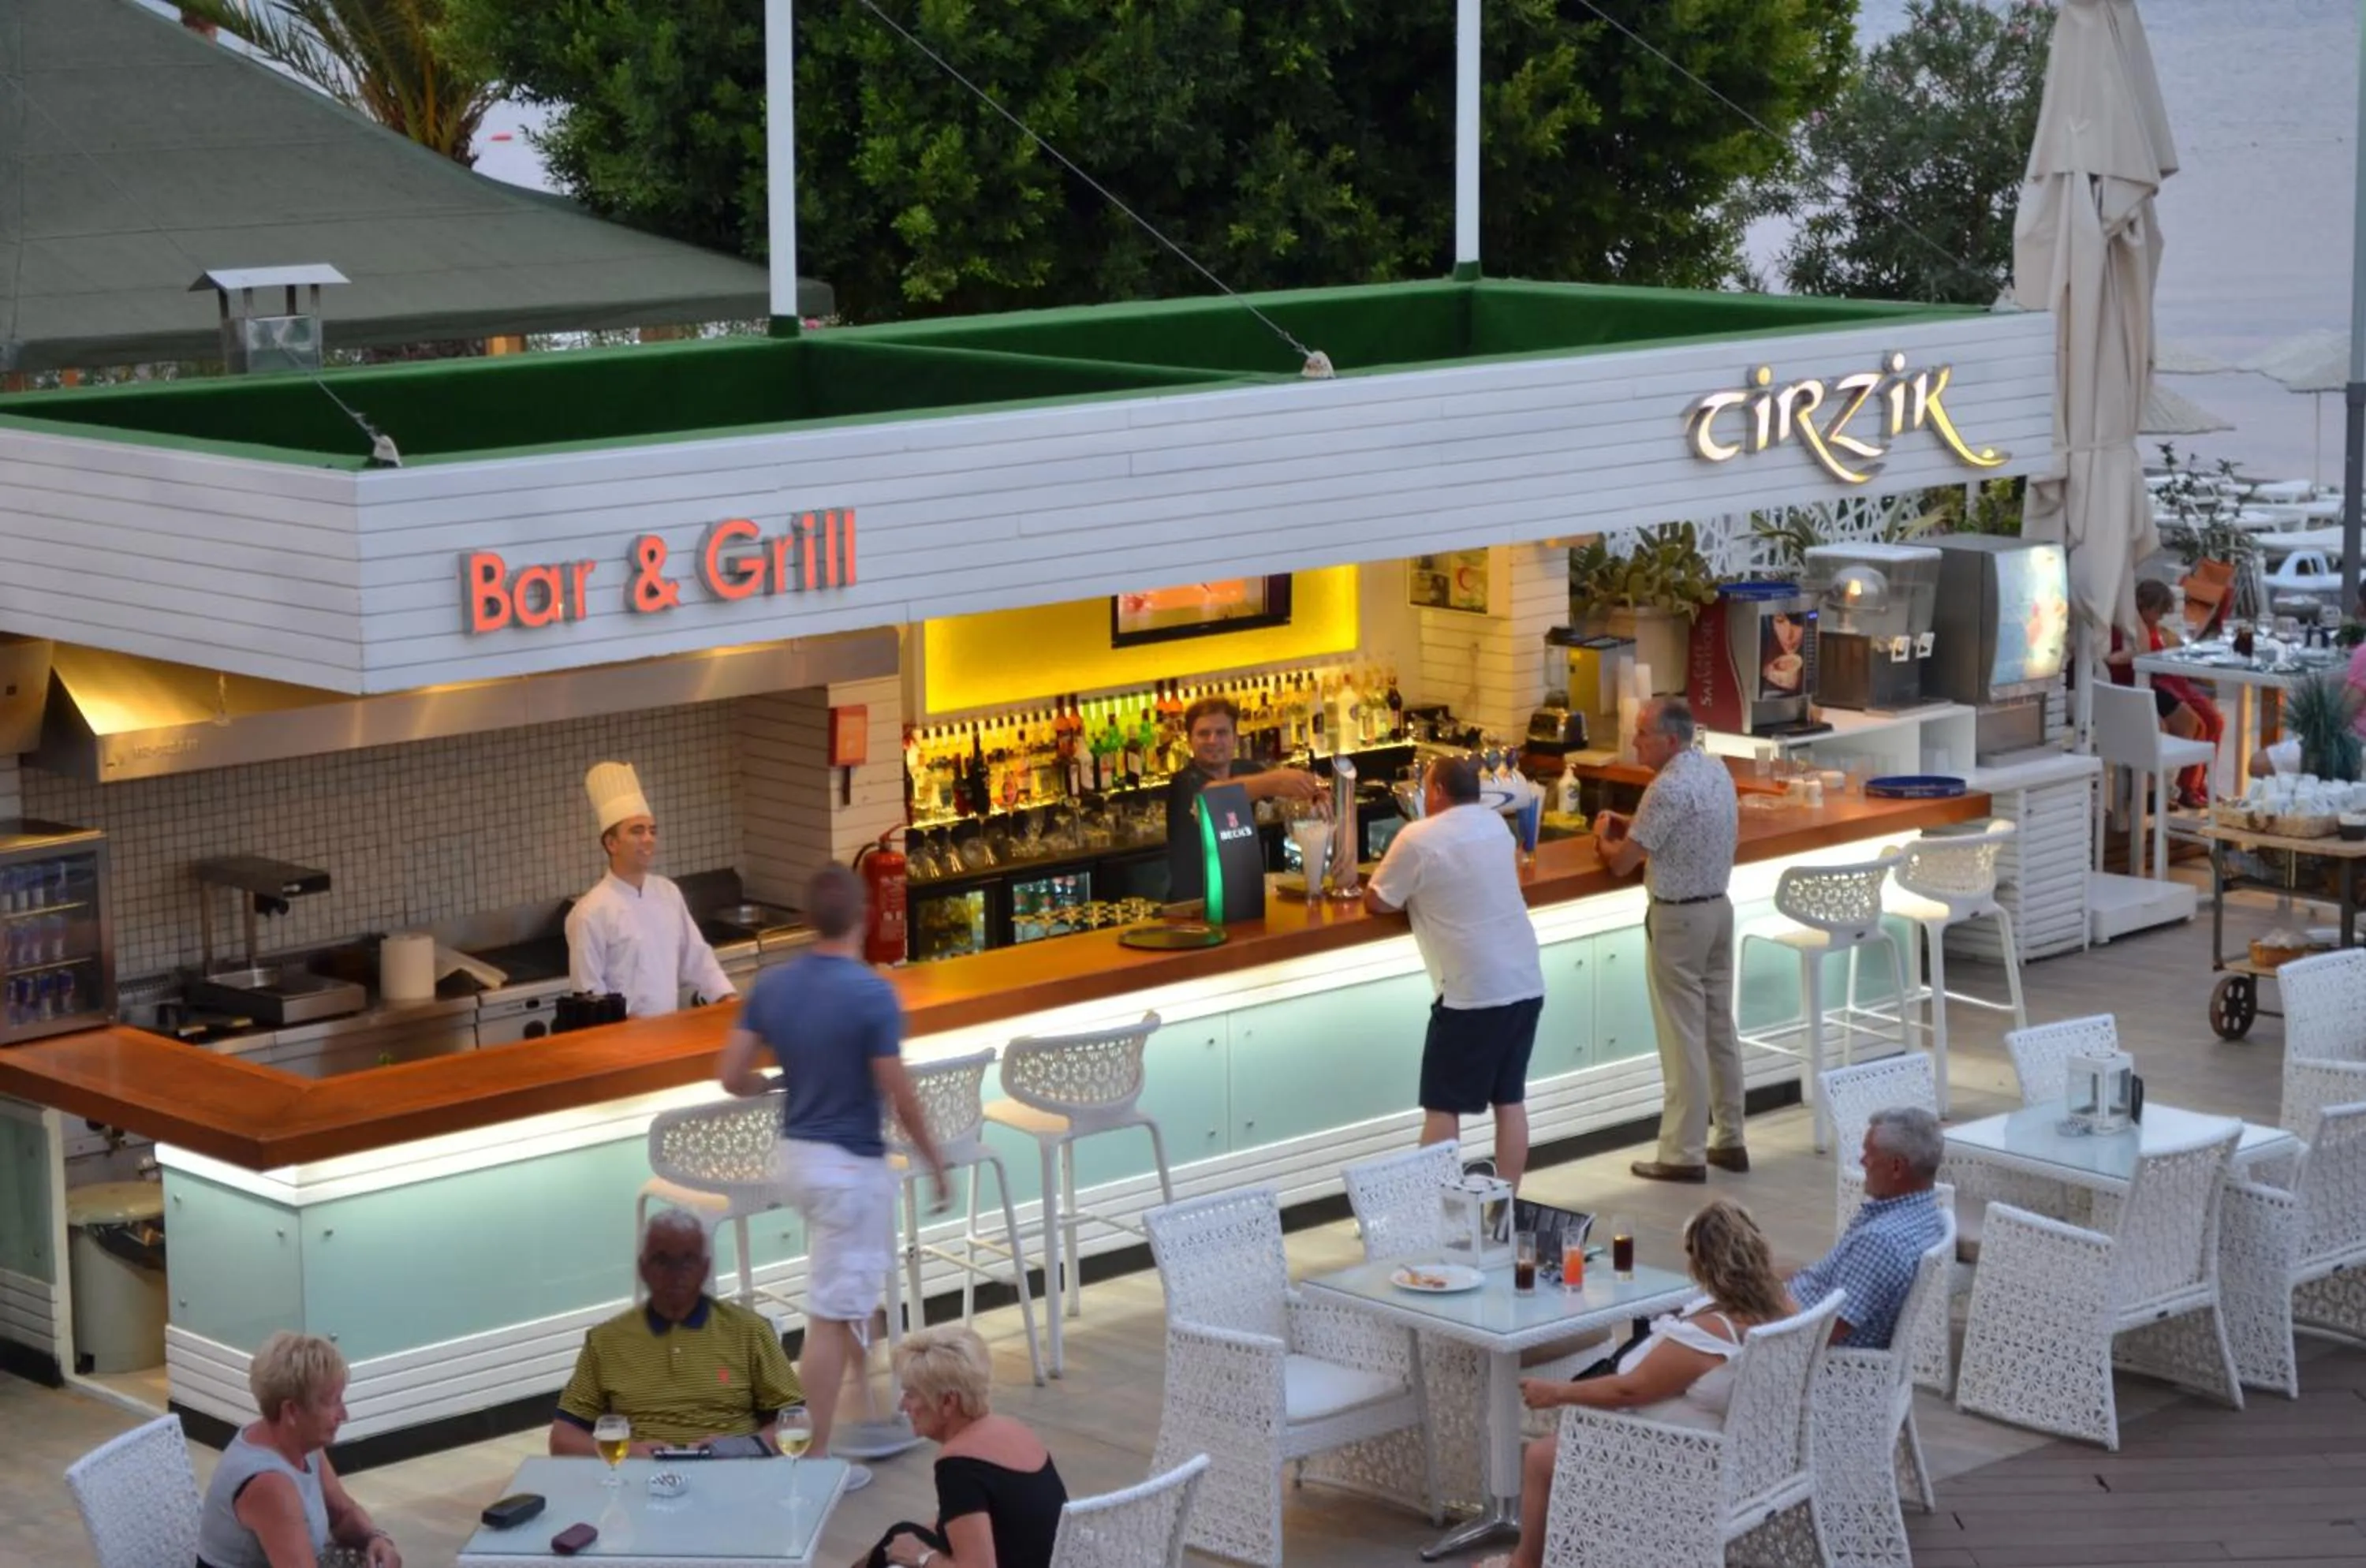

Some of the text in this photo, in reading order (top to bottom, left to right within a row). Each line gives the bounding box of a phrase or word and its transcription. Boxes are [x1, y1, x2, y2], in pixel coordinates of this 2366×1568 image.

[461, 507, 856, 636] Bar & Grill
